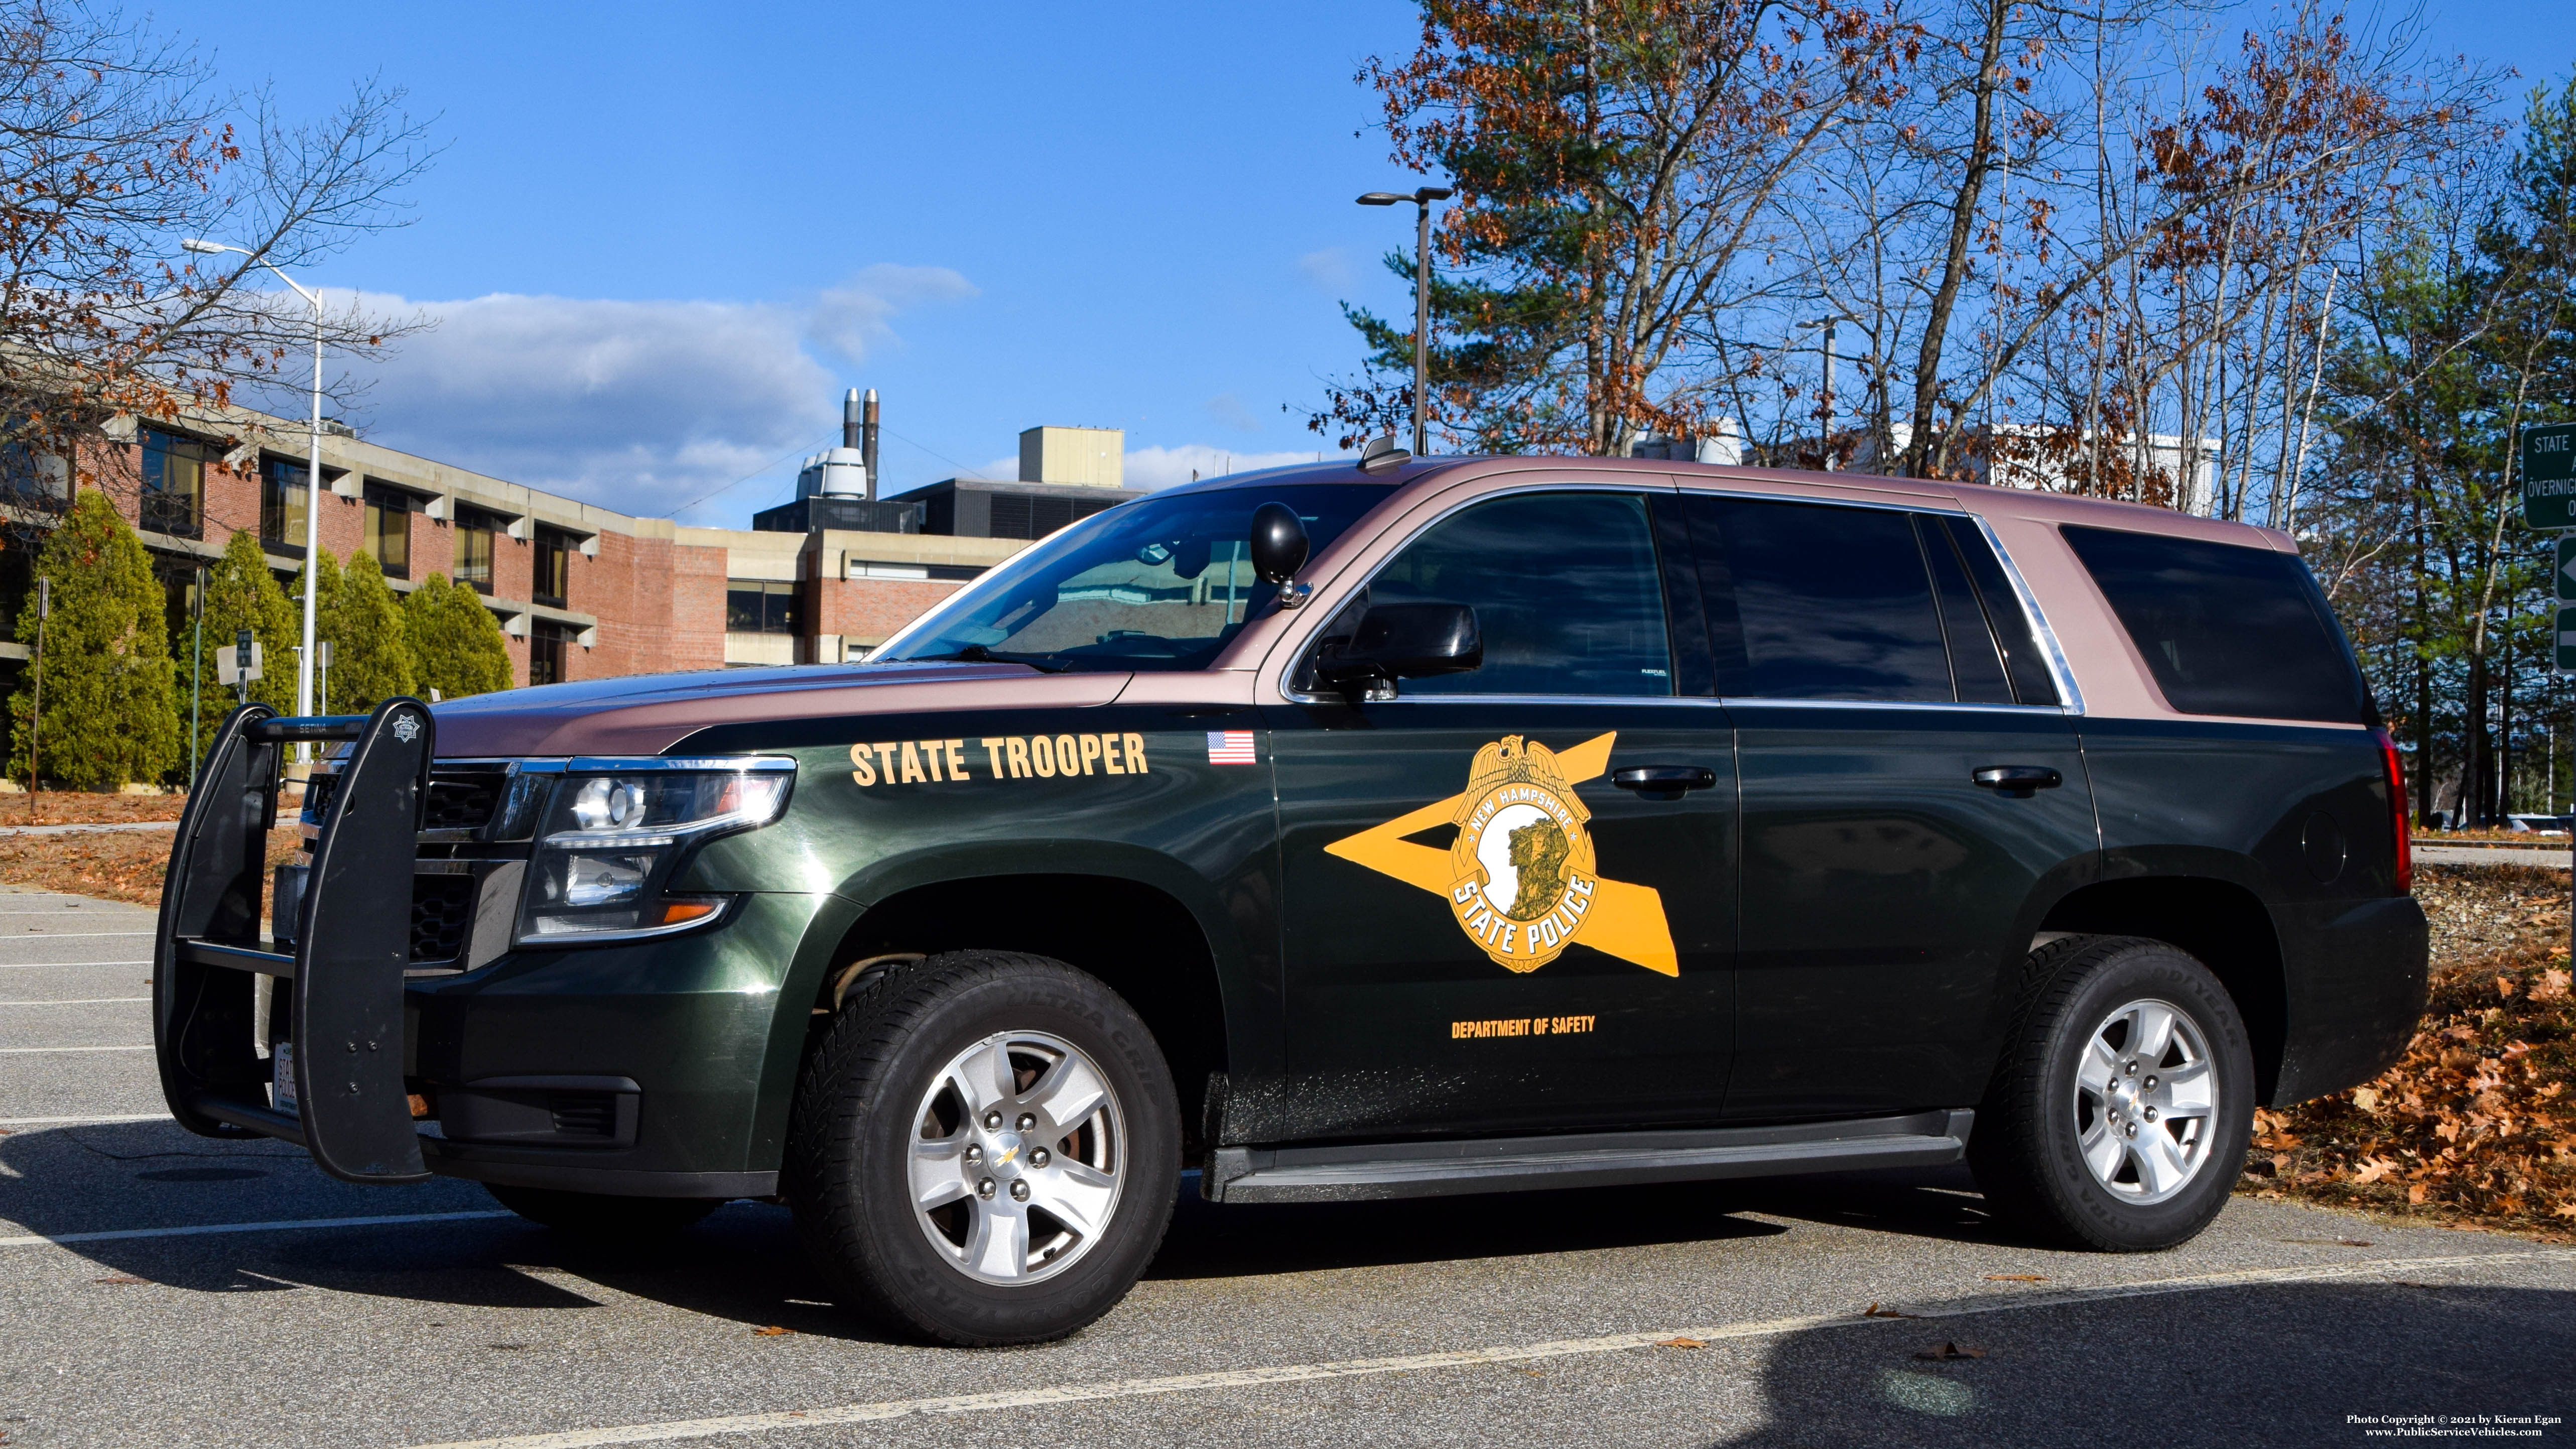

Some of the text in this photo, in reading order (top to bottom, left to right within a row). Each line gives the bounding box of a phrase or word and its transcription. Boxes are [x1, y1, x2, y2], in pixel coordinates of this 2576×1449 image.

[2535, 435, 2569, 453] STATE
[2528, 477, 2576, 498] OVERNIG
[299, 723, 327, 734] SETINA
[850, 733, 1148, 787] STATE TROOPER
[1470, 787, 1573, 831] NEW HAMPSHIRE
[1455, 874, 1594, 954] STATE POLICE
[1452, 1015, 1596, 1039] DEPARTMENT OF SAFETY
[279, 1057, 294, 1076] STAT
